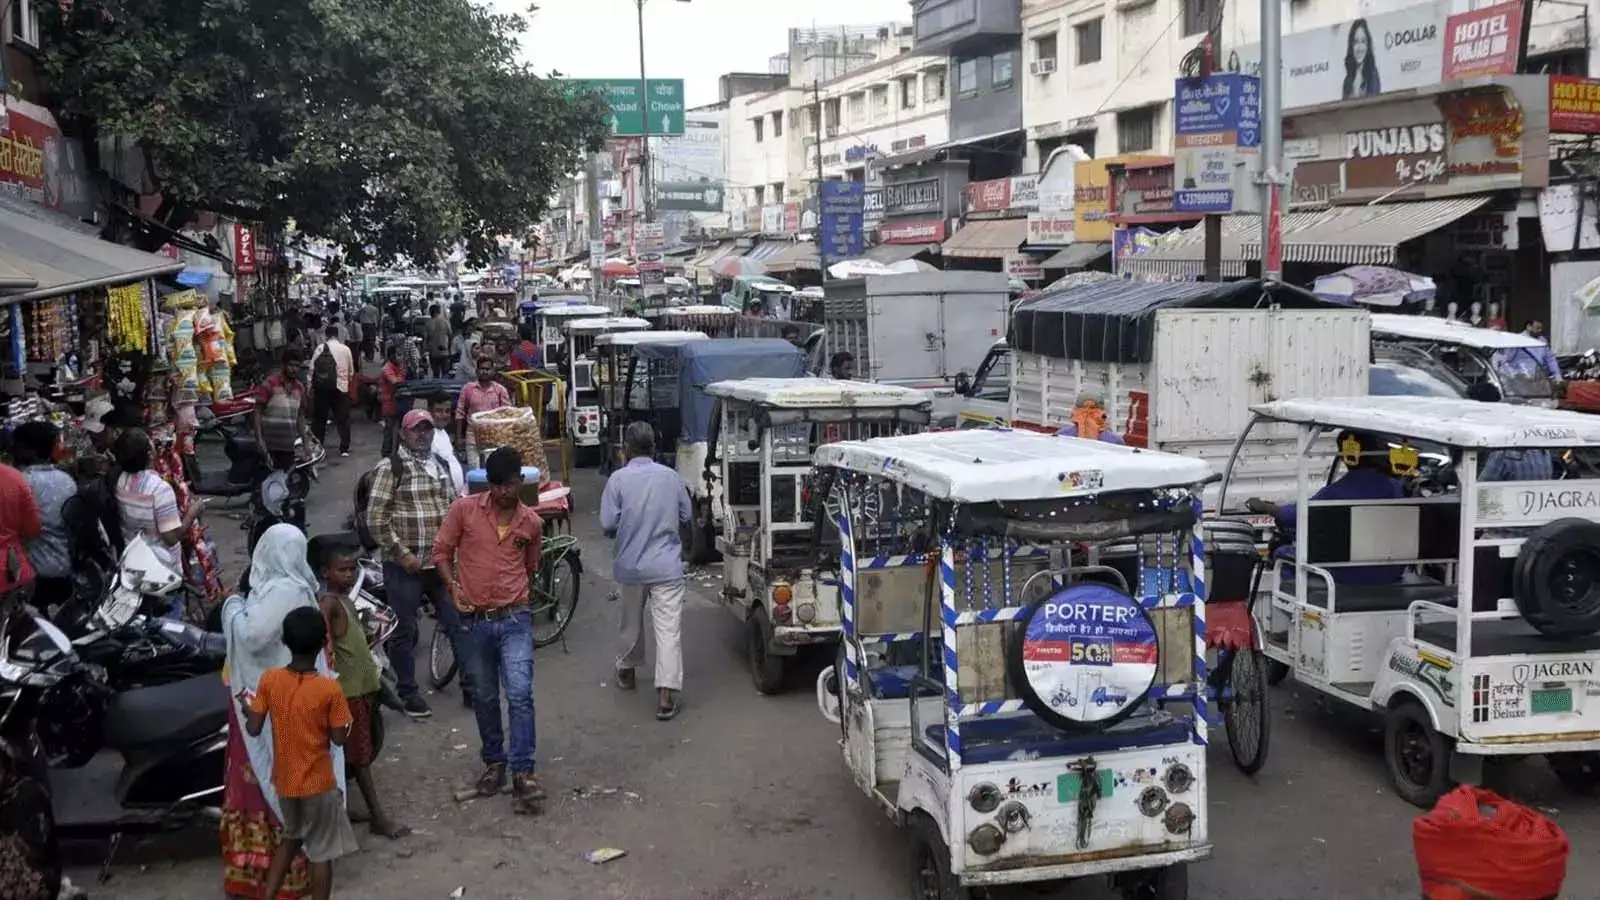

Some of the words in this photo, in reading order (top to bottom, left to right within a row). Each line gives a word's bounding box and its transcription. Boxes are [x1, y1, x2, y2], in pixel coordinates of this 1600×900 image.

[1394, 24, 1437, 46] DOLLAR
[1454, 14, 1508, 43] HOTEL
[1452, 39, 1490, 63] PUNJAB
[1314, 61, 1330, 75] SALE
[651, 101, 681, 112] Chowk
[1346, 123, 1446, 159] PUNJAB'S
[1412, 155, 1447, 183] Style
[1537, 490, 1600, 512] JAGRA
[1044, 603, 1128, 623] PORTER
[1532, 661, 1594, 680] JAGRAN
[1494, 709, 1526, 719] Deluxe
